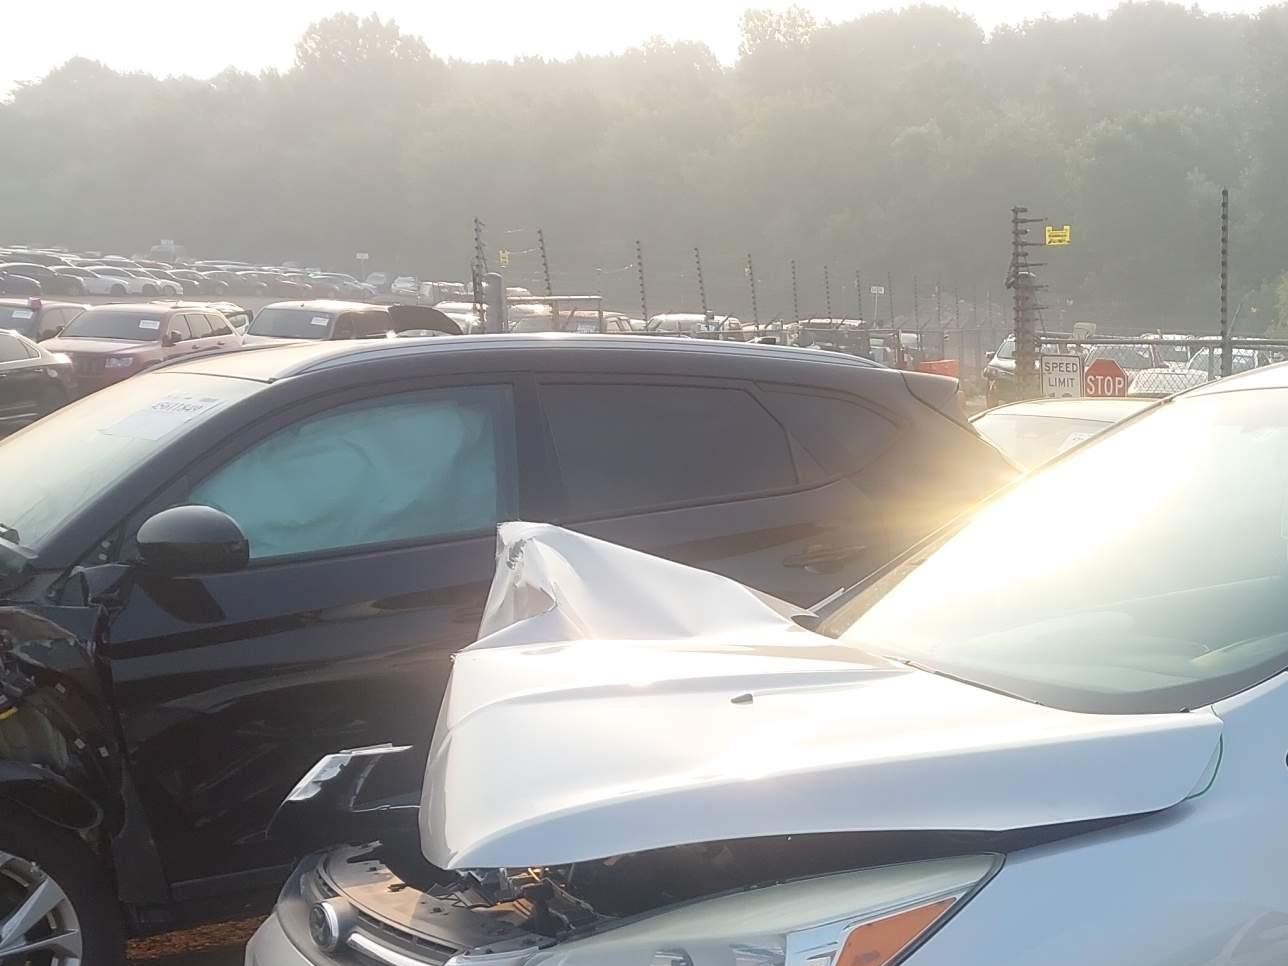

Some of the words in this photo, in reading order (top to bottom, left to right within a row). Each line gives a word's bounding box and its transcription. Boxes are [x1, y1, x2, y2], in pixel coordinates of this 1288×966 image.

[1045, 362, 1078, 373] SPEED
[1048, 377, 1075, 388] LIMIT
[1086, 375, 1124, 396] STOP
